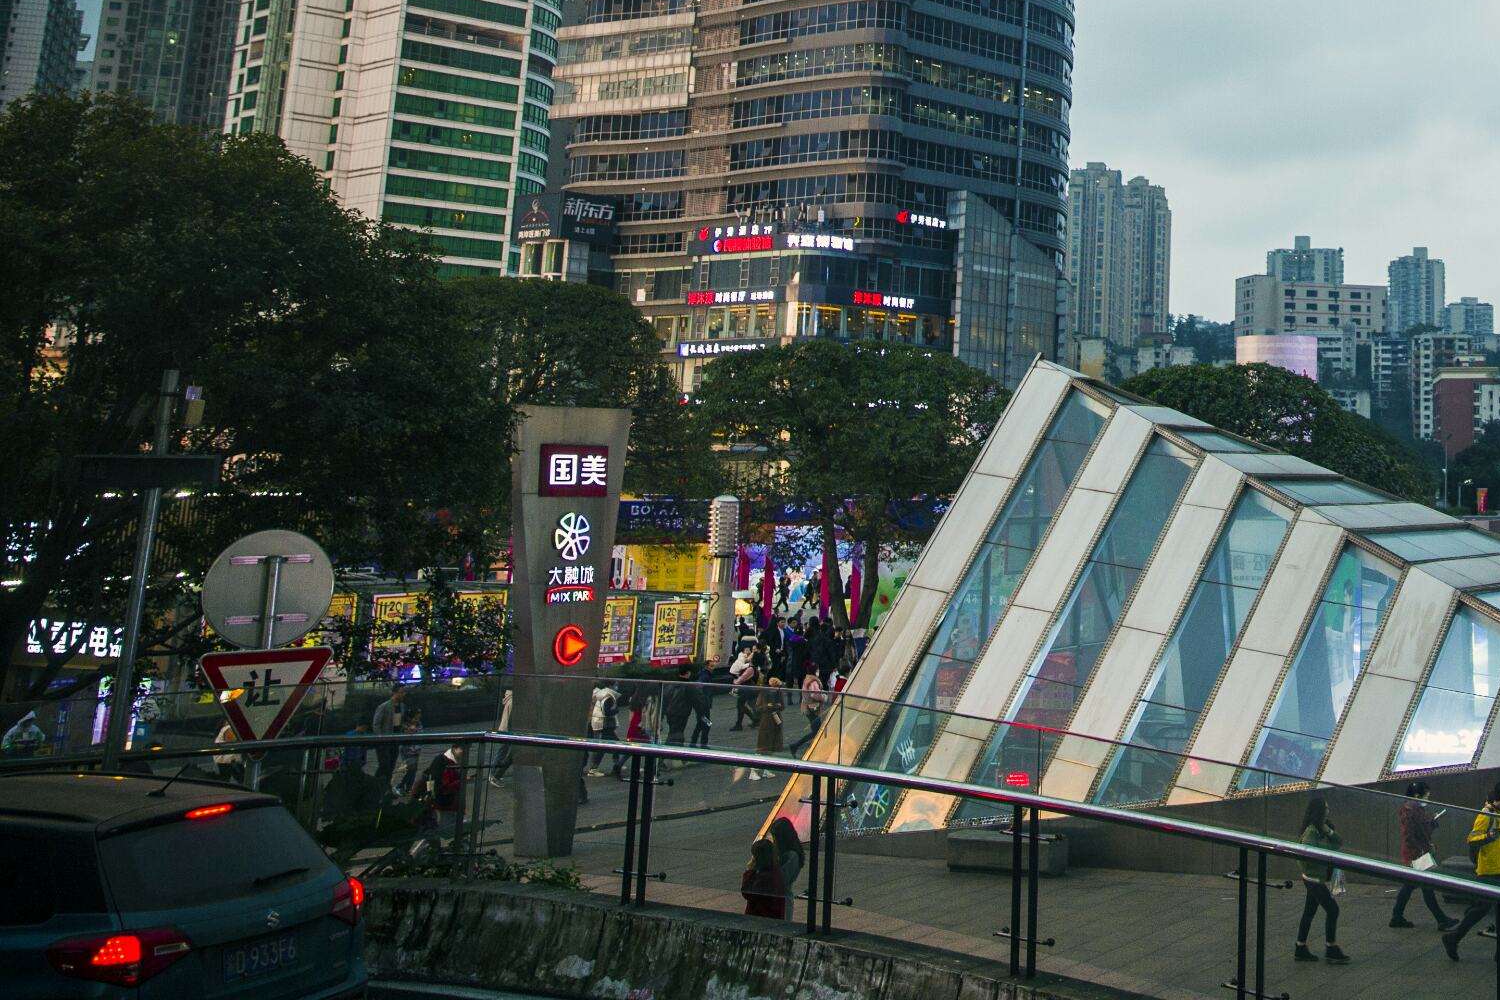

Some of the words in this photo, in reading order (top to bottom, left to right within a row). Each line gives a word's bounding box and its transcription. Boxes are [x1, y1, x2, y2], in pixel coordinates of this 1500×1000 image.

[564, 198, 615, 222] 新东方
[549, 454, 607, 486] 国美
[549, 566, 594, 585] 大融城
[550, 590, 571, 603] MIX
[572, 588, 594, 602] PARK
[242, 668, 282, 708] 让
